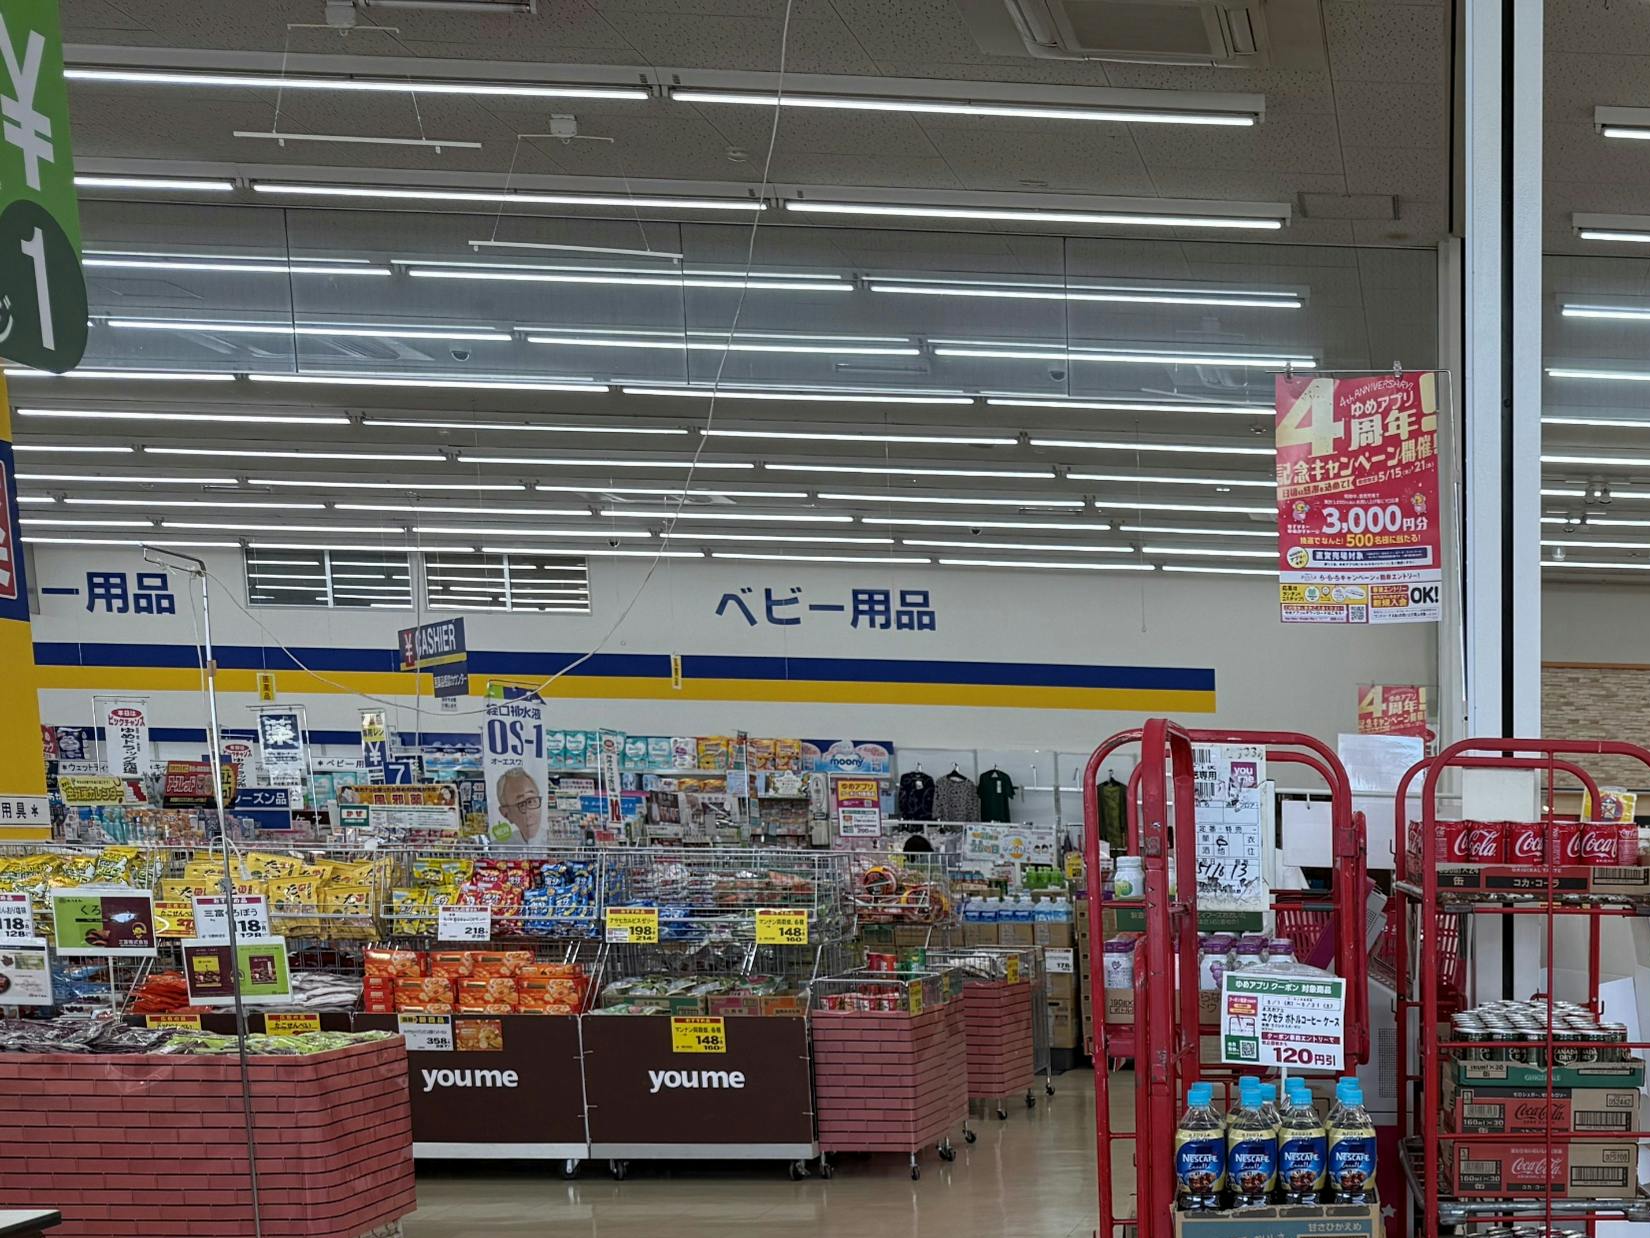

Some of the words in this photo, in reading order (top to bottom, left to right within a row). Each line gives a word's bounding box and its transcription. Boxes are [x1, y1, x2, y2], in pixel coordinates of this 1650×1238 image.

[20, 227, 55, 351] 1
[1350, 391, 1414, 416] ゆめアプリ
[1411, 587, 1439, 604] OK!
[715, 586, 936, 631] ベビー用品
[416, 621, 455, 656] CASHIER
[487, 720, 544, 758] OS-1
[629, 926, 652, 935] 198
[779, 928, 801, 937] 148
[1271, 982, 1299, 992] クーポン
[421, 1068, 519, 1093] youme
[648, 1069, 745, 1093] youme
[1308, 1222, 1362, 1232] 甘さひかえめ
